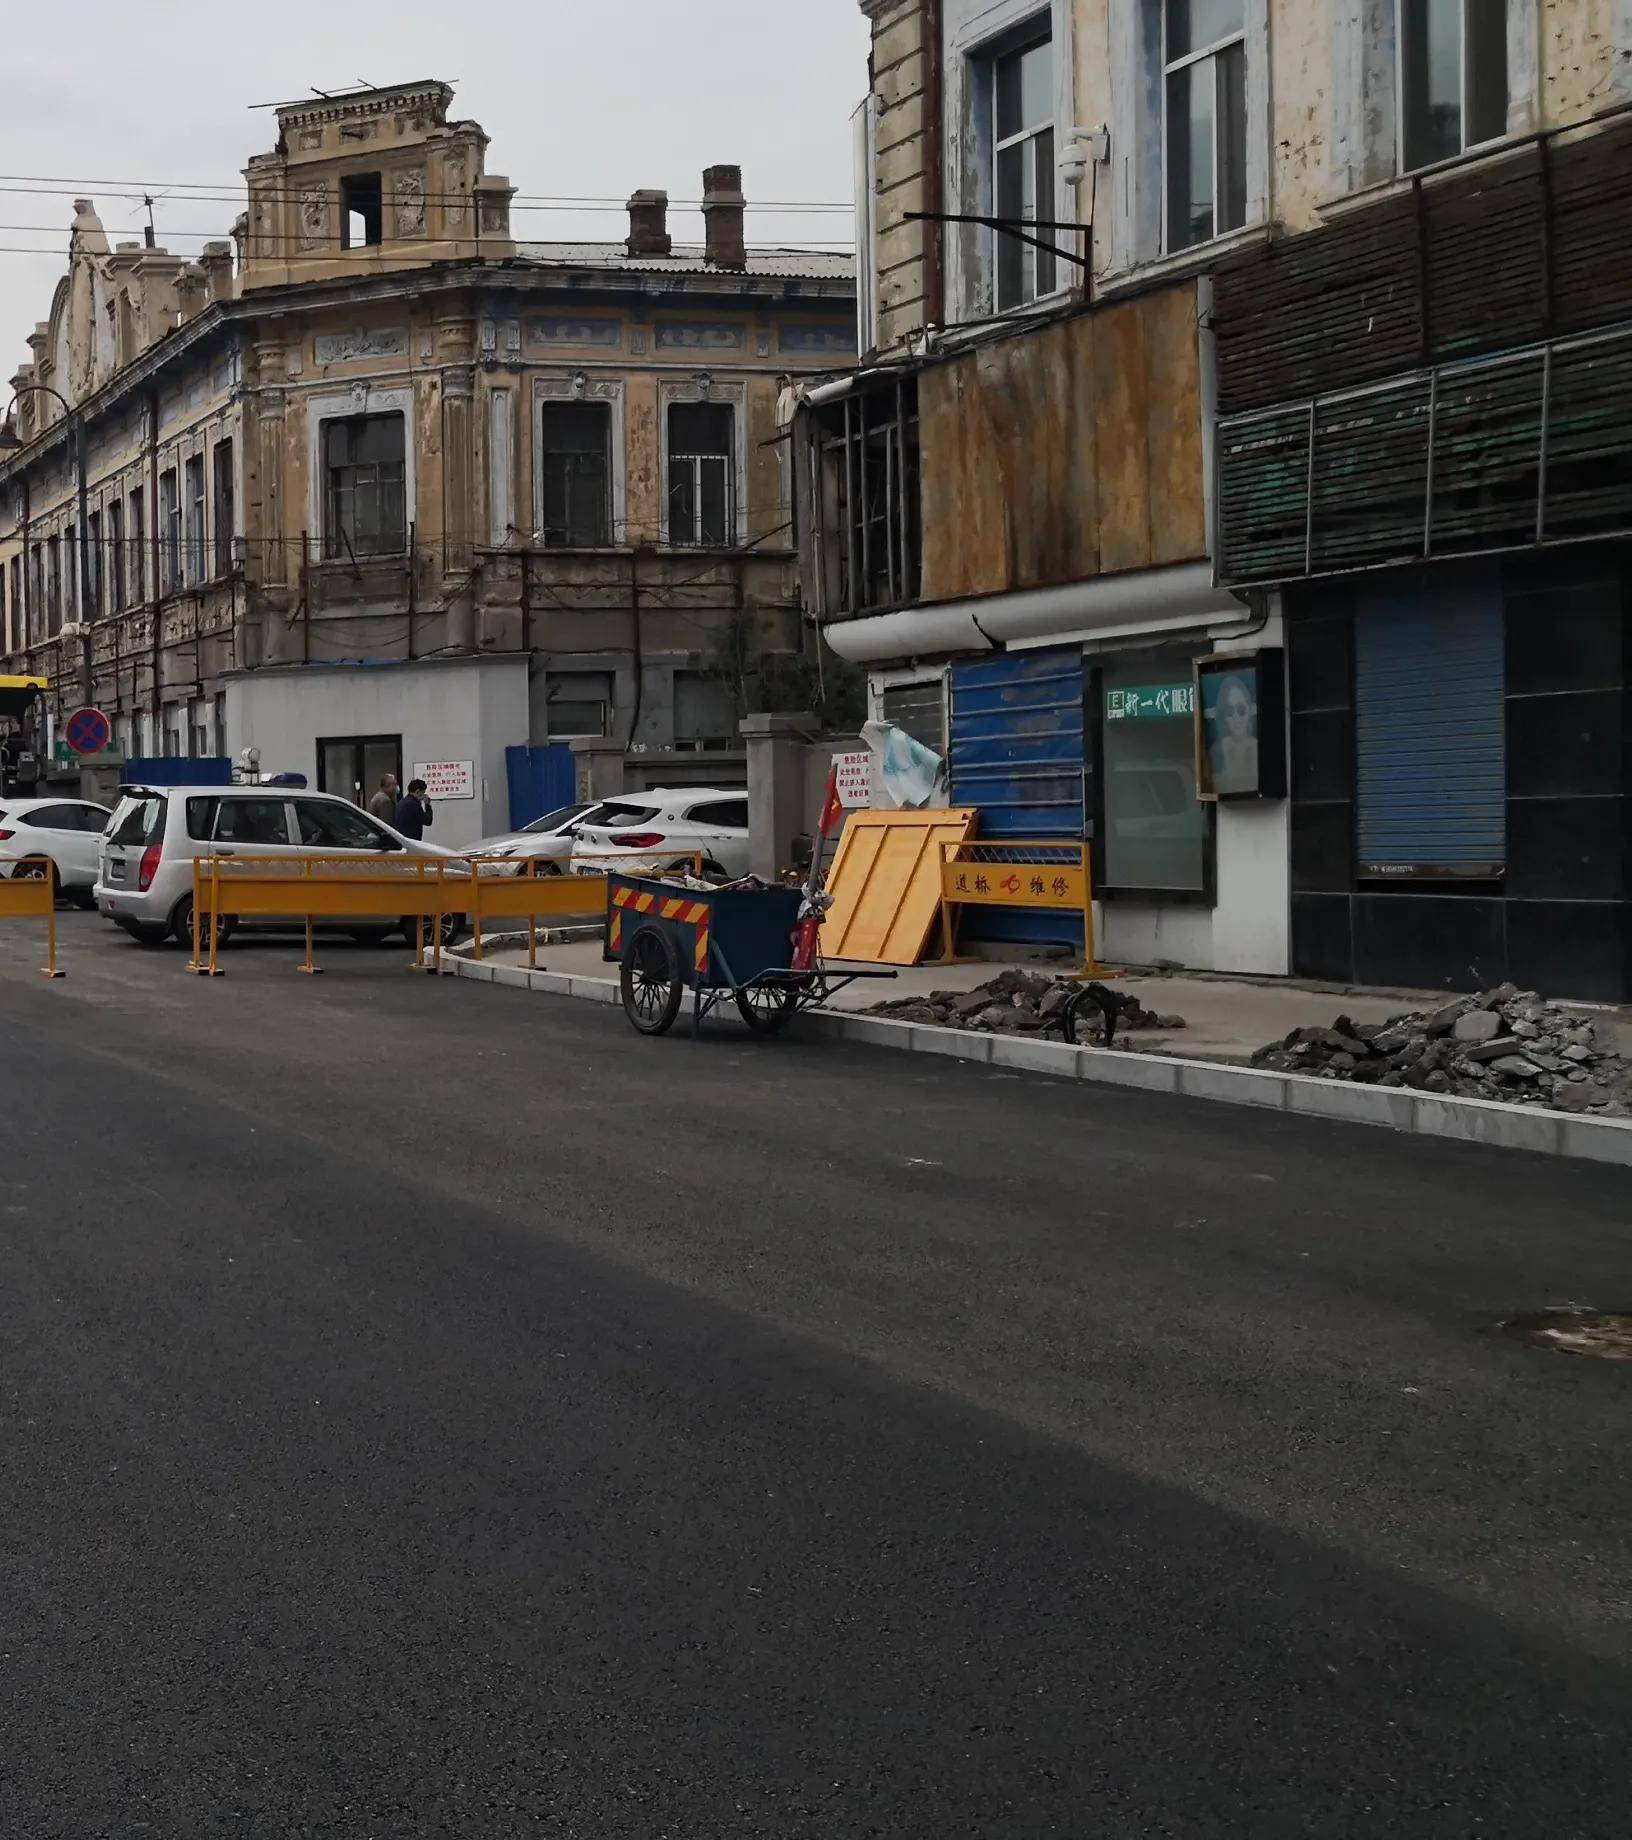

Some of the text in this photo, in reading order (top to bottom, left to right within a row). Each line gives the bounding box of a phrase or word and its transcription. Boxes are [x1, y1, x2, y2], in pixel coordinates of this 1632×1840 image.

[1125, 687, 1195, 717] 新一代眼
[955, 873, 1070, 897] 道桥 维修
